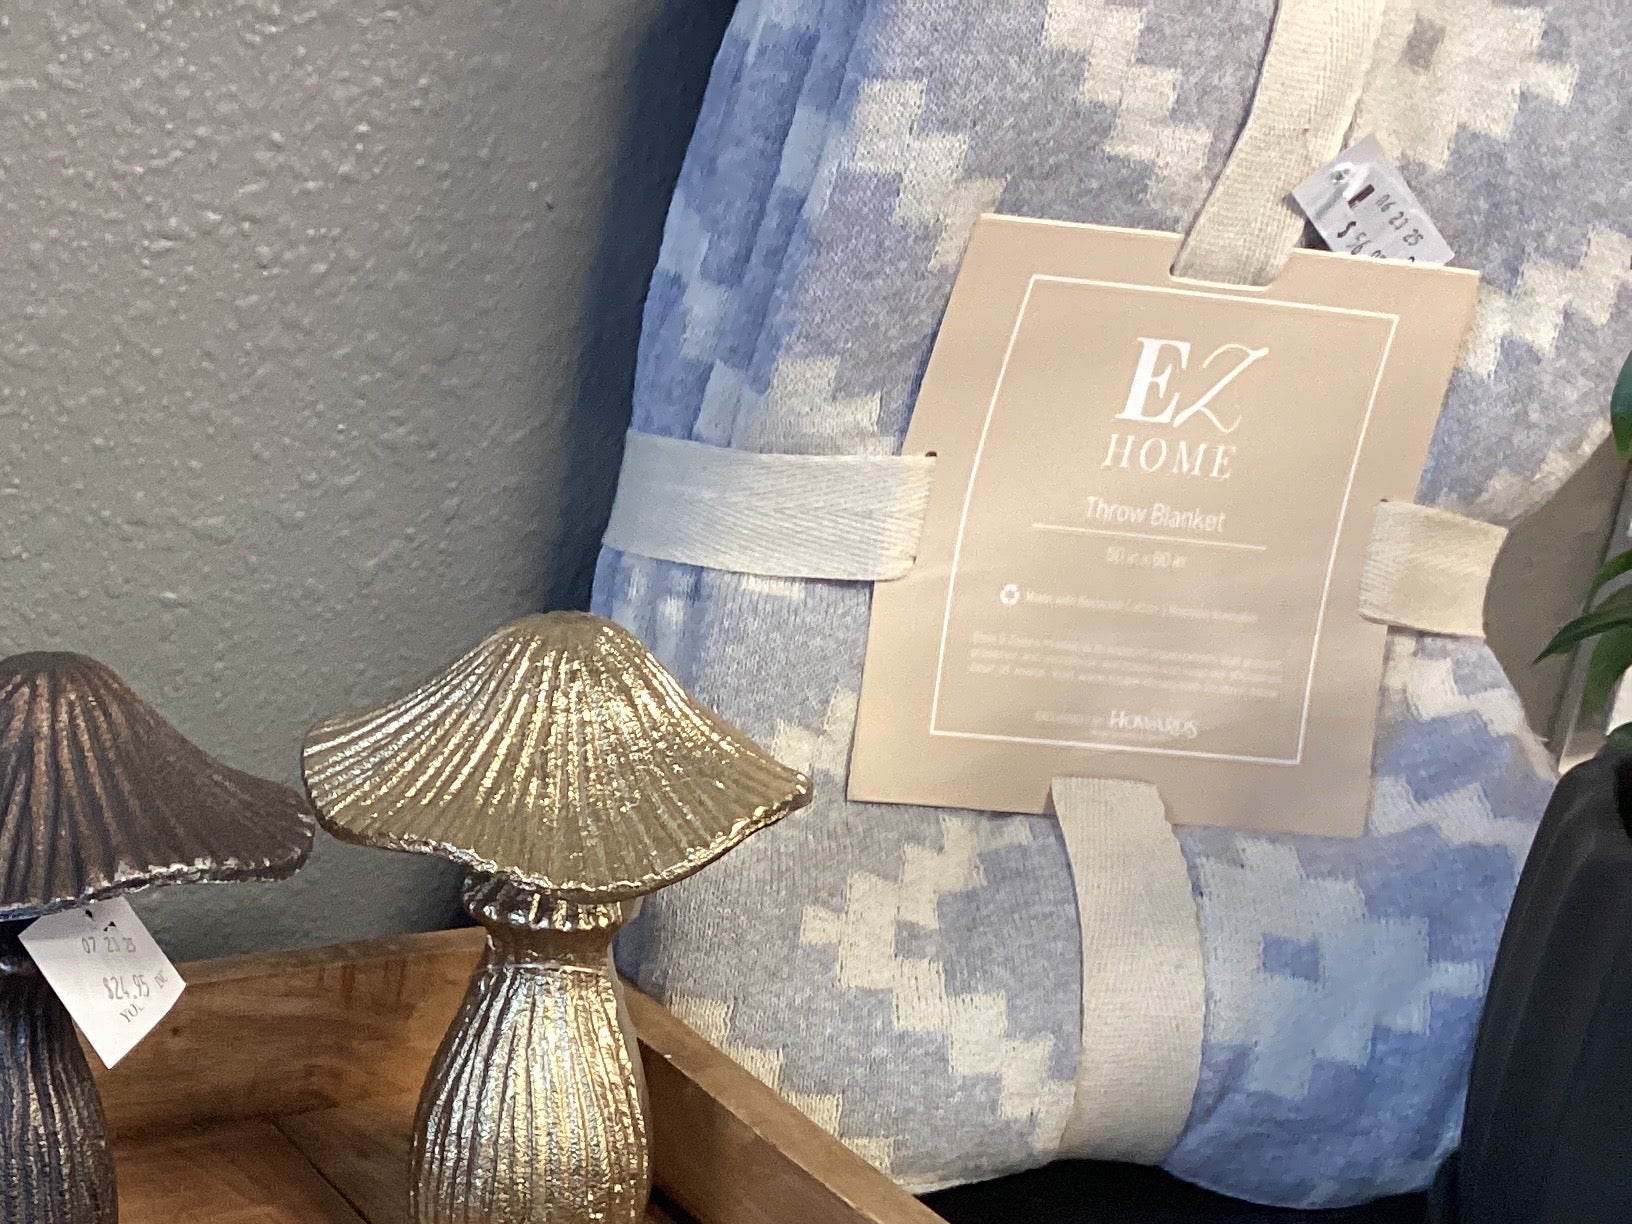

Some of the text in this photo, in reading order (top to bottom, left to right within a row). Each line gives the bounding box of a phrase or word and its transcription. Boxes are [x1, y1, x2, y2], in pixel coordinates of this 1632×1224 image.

[1389, 210, 1408, 230] 23
[1403, 228, 1424, 246] 25
[1114, 336, 1270, 434] EZ
[1101, 433, 1237, 480] HOME
[1085, 496, 1227, 533] Throw Blanket
[81, 936, 96, 954] 07
[102, 974, 150, 1000] $24.95
